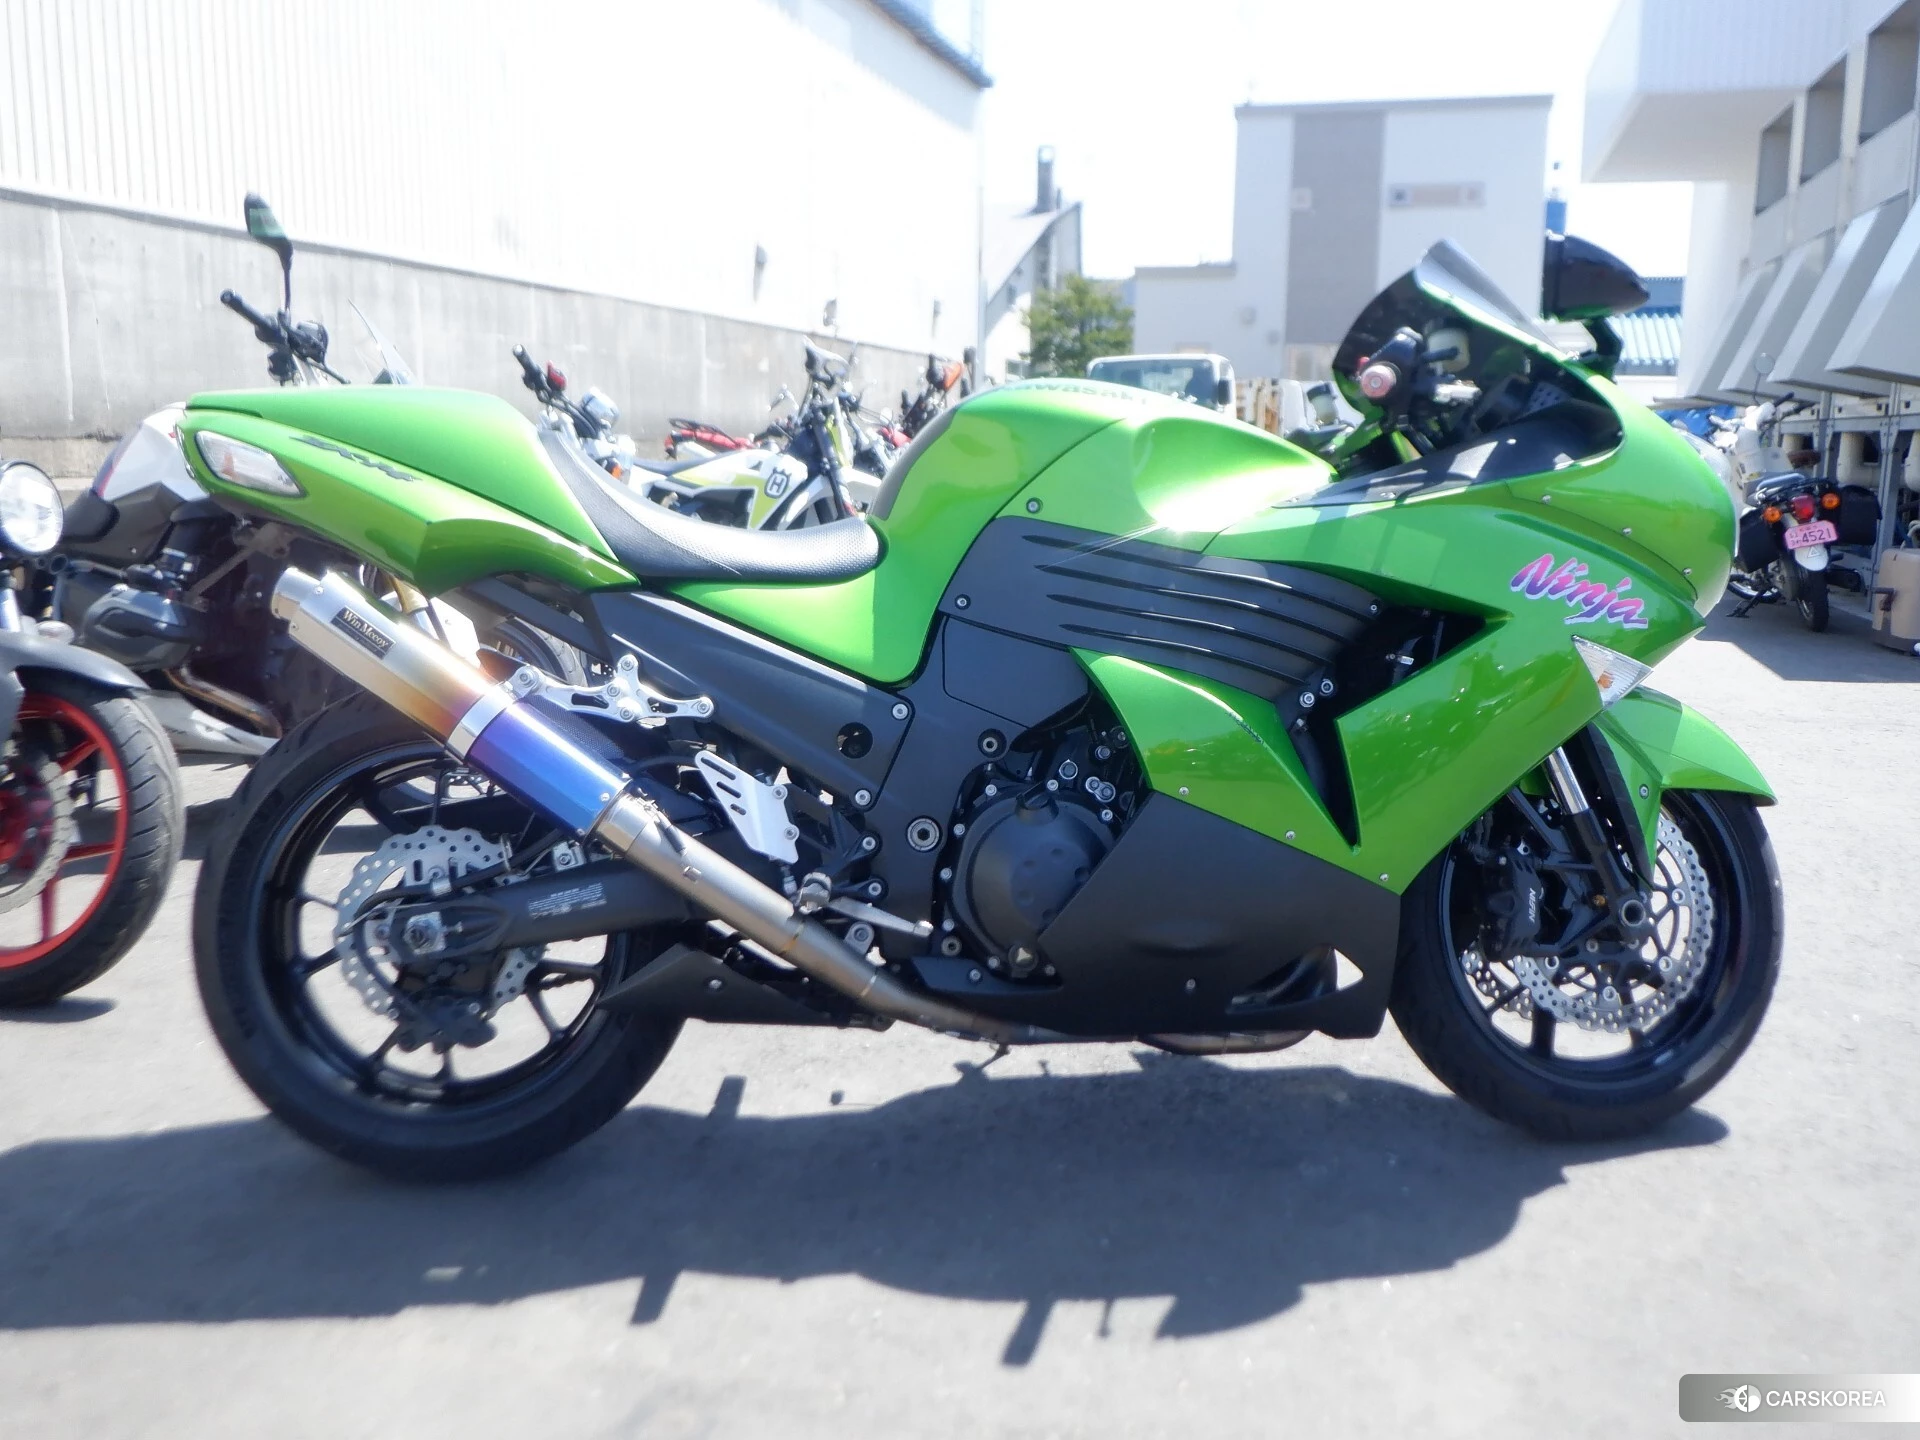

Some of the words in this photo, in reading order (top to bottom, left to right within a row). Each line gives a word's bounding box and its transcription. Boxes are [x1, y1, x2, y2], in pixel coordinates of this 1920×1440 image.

[1802, 527, 1831, 543] 4521
[1510, 553, 1649, 629] Ninja
[343, 609, 362, 629] Win
